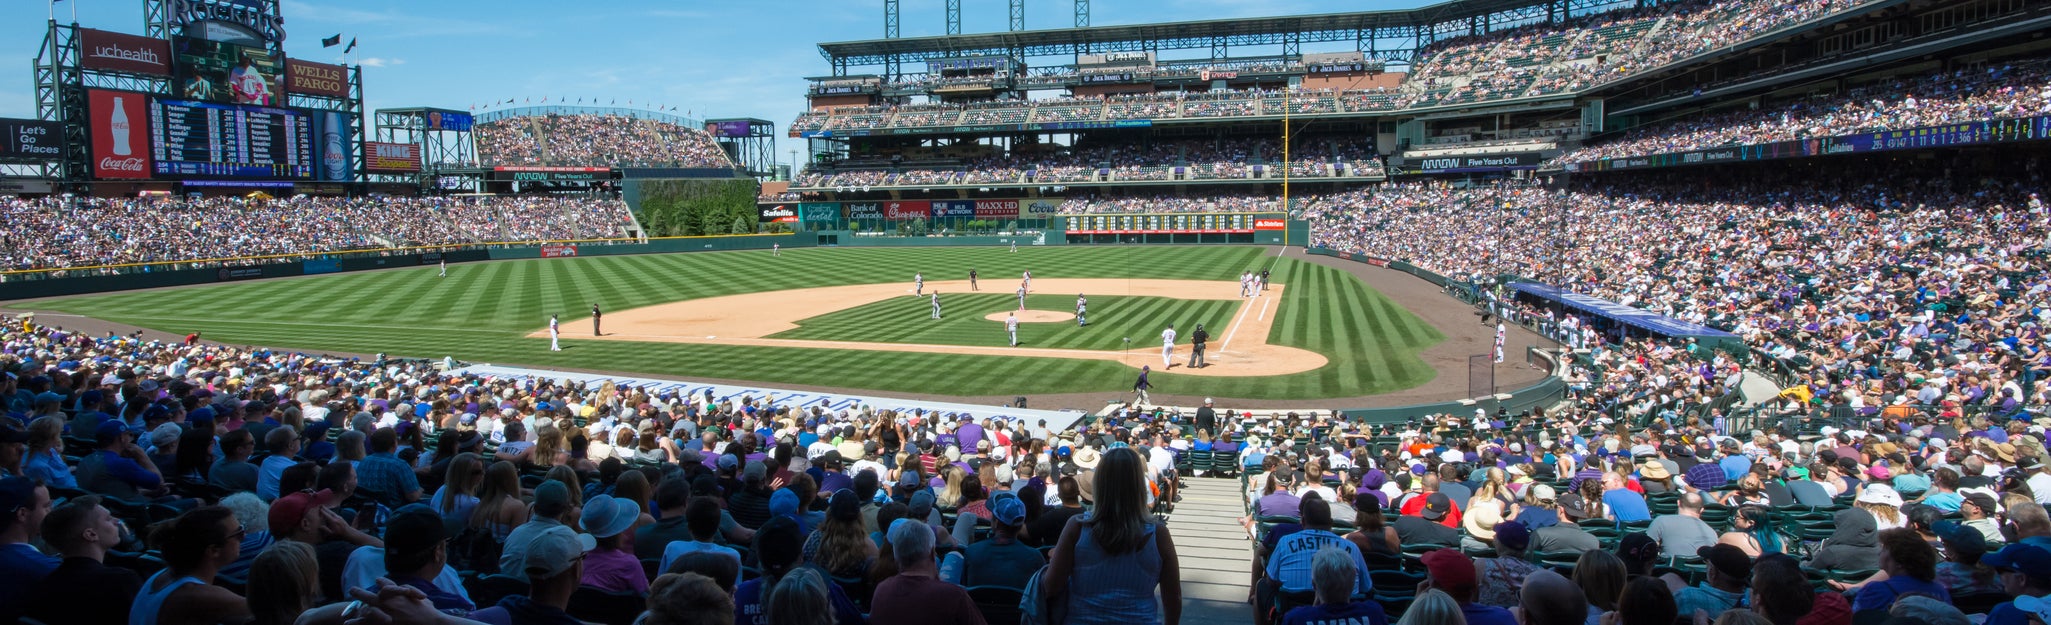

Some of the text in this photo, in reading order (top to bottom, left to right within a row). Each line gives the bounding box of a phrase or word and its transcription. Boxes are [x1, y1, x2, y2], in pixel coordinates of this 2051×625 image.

[167, 0, 286, 42] ROCKIES
[95, 43, 160, 64] uchealth
[292, 64, 341, 81] WELLS
[295, 77, 341, 92] FARGO
[1998, 120, 2004, 130] 4
[2014, 119, 2020, 130] 7
[2028, 118, 2033, 128] 1
[20, 125, 47, 135] Let's
[2027, 129, 2033, 139] 0
[20, 135, 37, 143] Go
[21, 144, 60, 154] Places
[376, 144, 411, 158] KING
[1829, 143, 1854, 153] LeMahieu
[100, 157, 146, 172] Coca-Cola
[376, 157, 412, 169] Soopers
[1421, 157, 1518, 169] ARROW Five Years Out
[514, 172, 548, 180] ARROW
[851, 203, 877, 212] Bank of
[1004, 201, 1018, 209] HD
[1028, 202, 1055, 214] Coors
[763, 209, 794, 217] Safelite
[851, 211, 883, 219] Colorado
